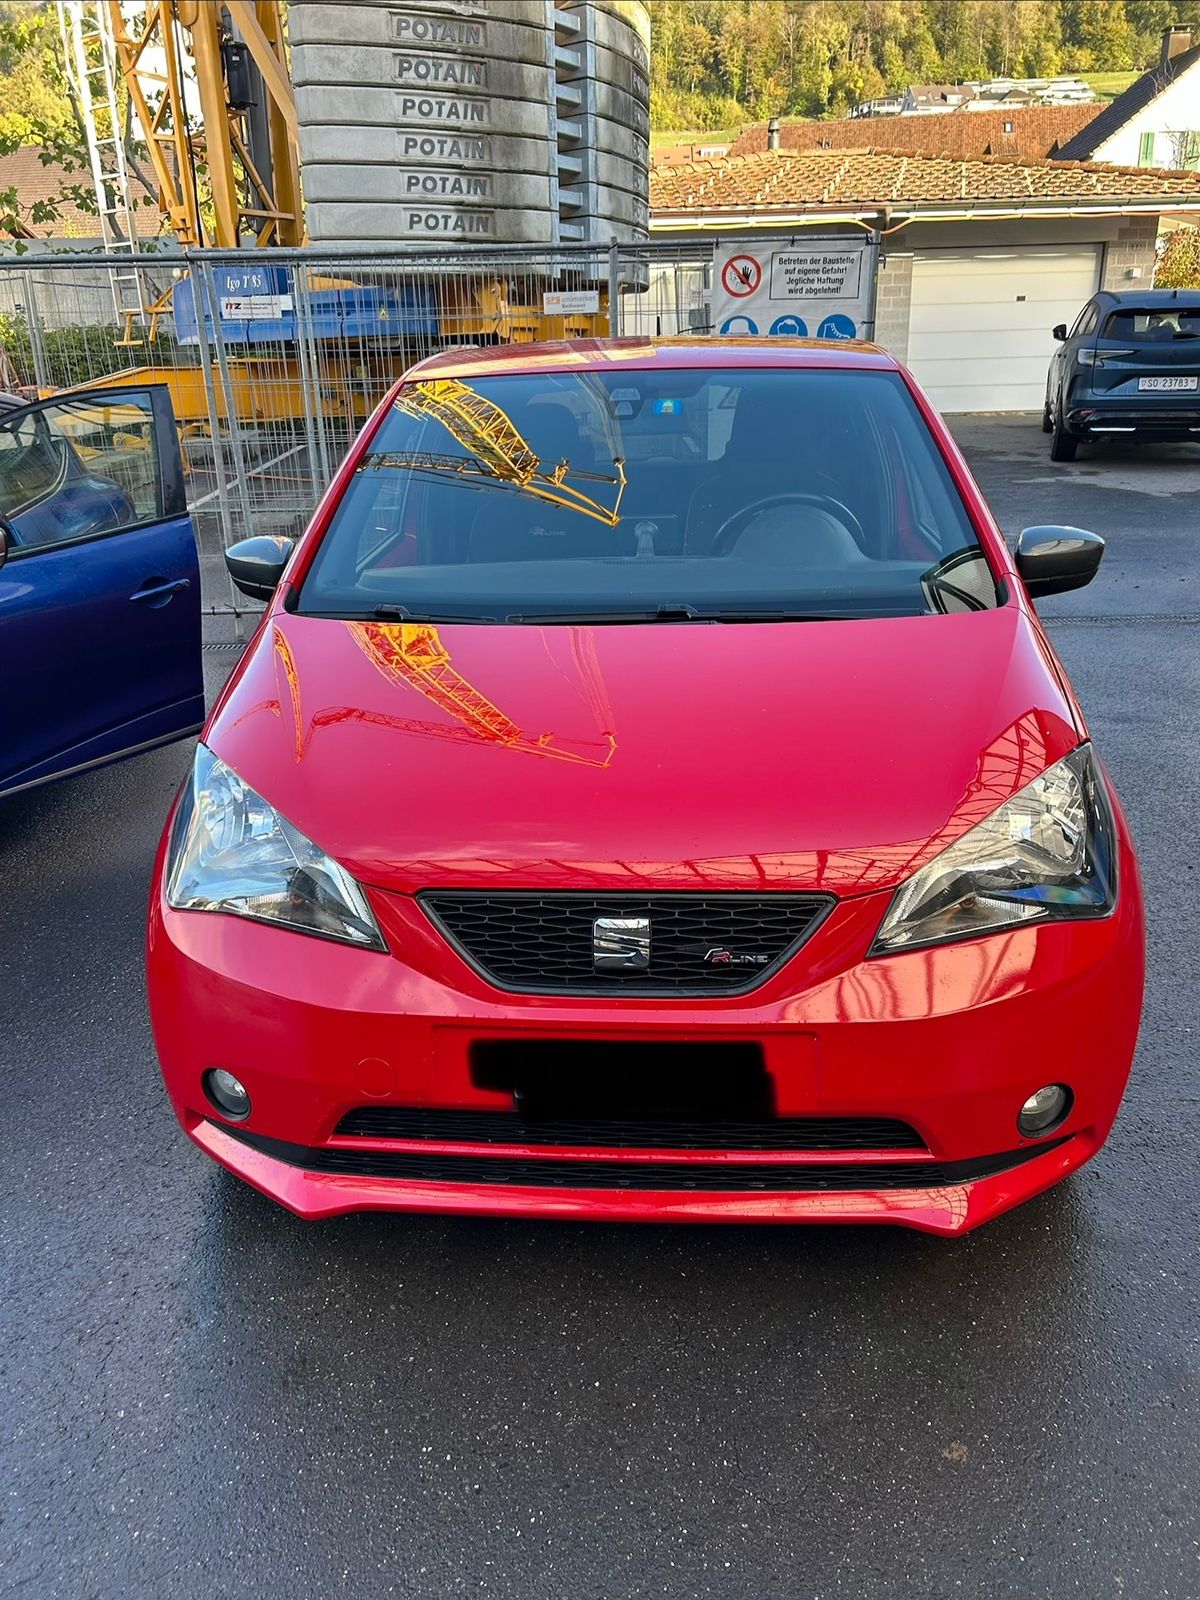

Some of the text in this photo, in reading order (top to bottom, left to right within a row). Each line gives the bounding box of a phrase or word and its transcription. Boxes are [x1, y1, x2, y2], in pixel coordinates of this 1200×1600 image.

[396, 17, 480, 44] POTAIN
[398, 58, 481, 84] POTAIN
[402, 98, 484, 121] POTAIN
[404, 137, 485, 159] POTAIN
[406, 175, 487, 195] POTAIN
[408, 213, 489, 233] POTAIN
[778, 257, 855, 265] Betreten der Baustelle
[784, 266, 848, 276] auf eigene Gefahr!
[226, 274, 262, 292] Igo T 85
[786, 277, 844, 286] Jegliche Haftung
[805, 286, 842, 295] abgelehnt!
[1147, 378, 1189, 388] SO 23783
